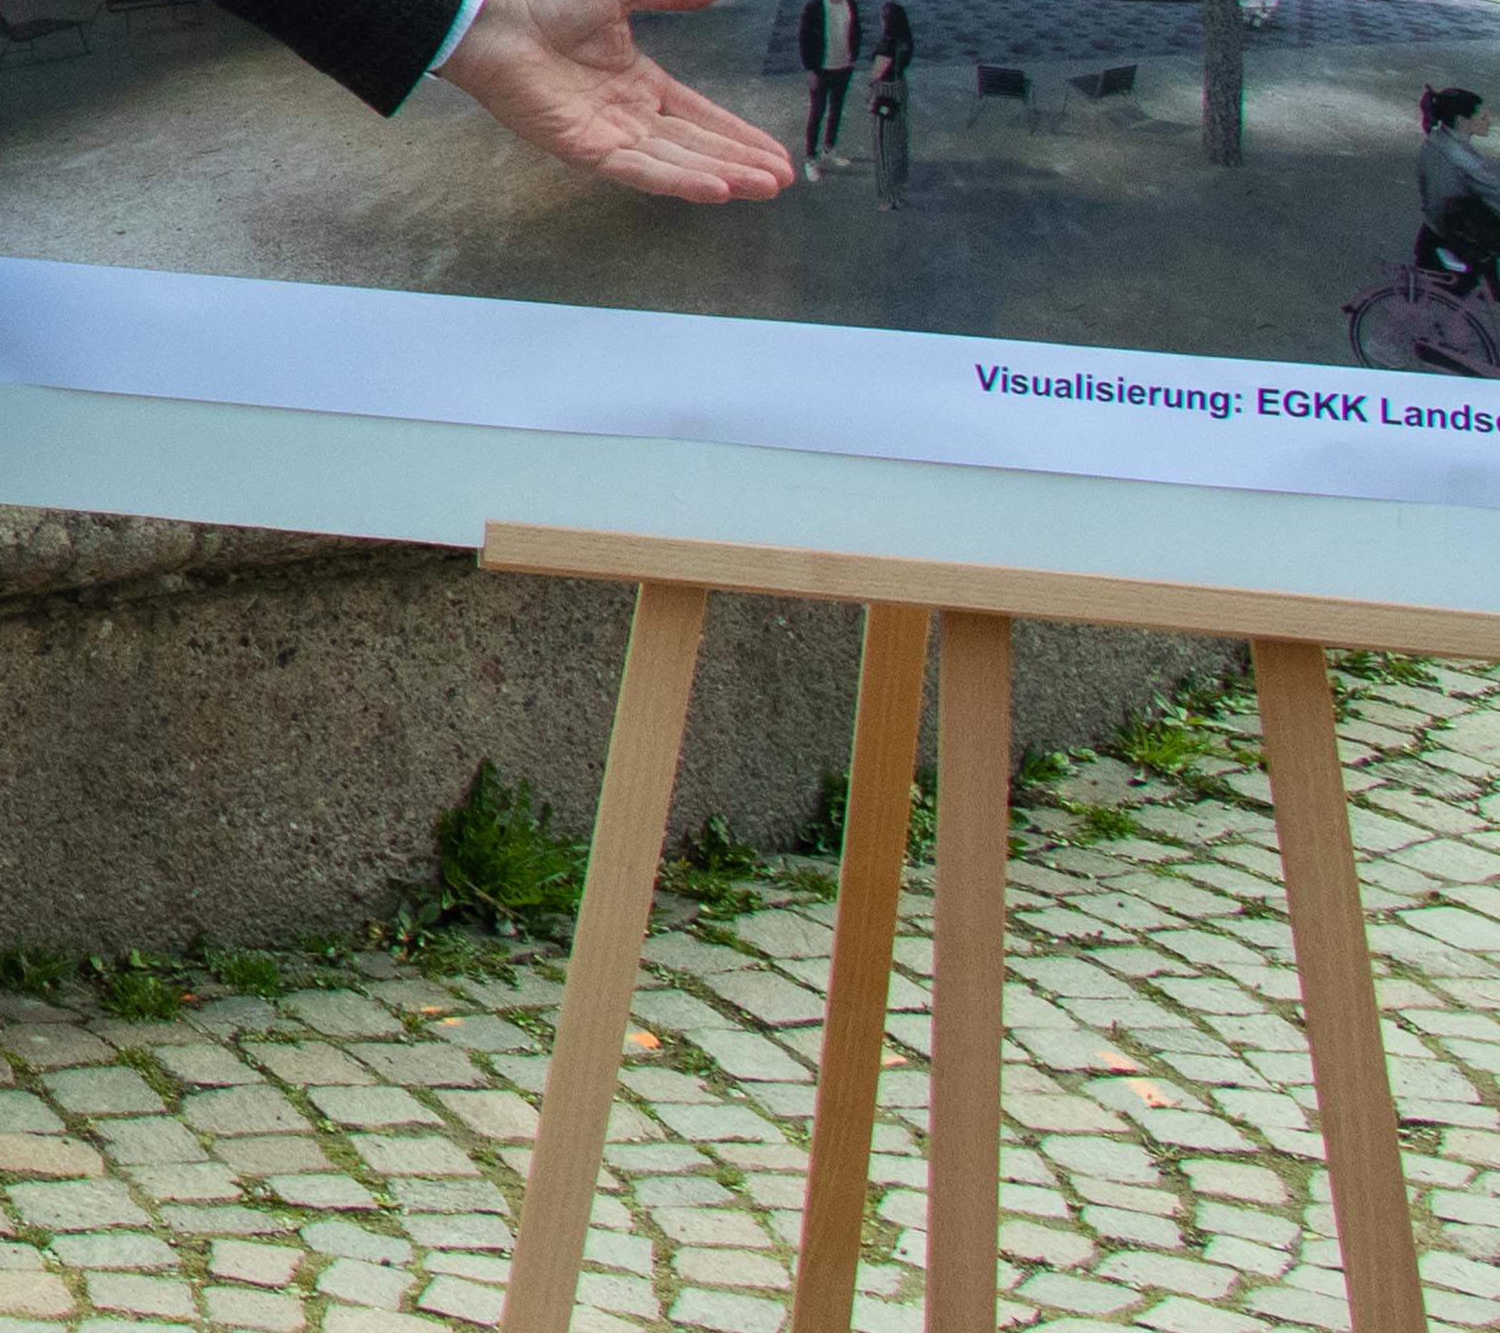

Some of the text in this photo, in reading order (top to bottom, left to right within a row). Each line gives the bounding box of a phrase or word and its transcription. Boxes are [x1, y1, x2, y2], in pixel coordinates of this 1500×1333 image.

[974, 363, 1500, 433] Visualisierung: EGKK Lands
